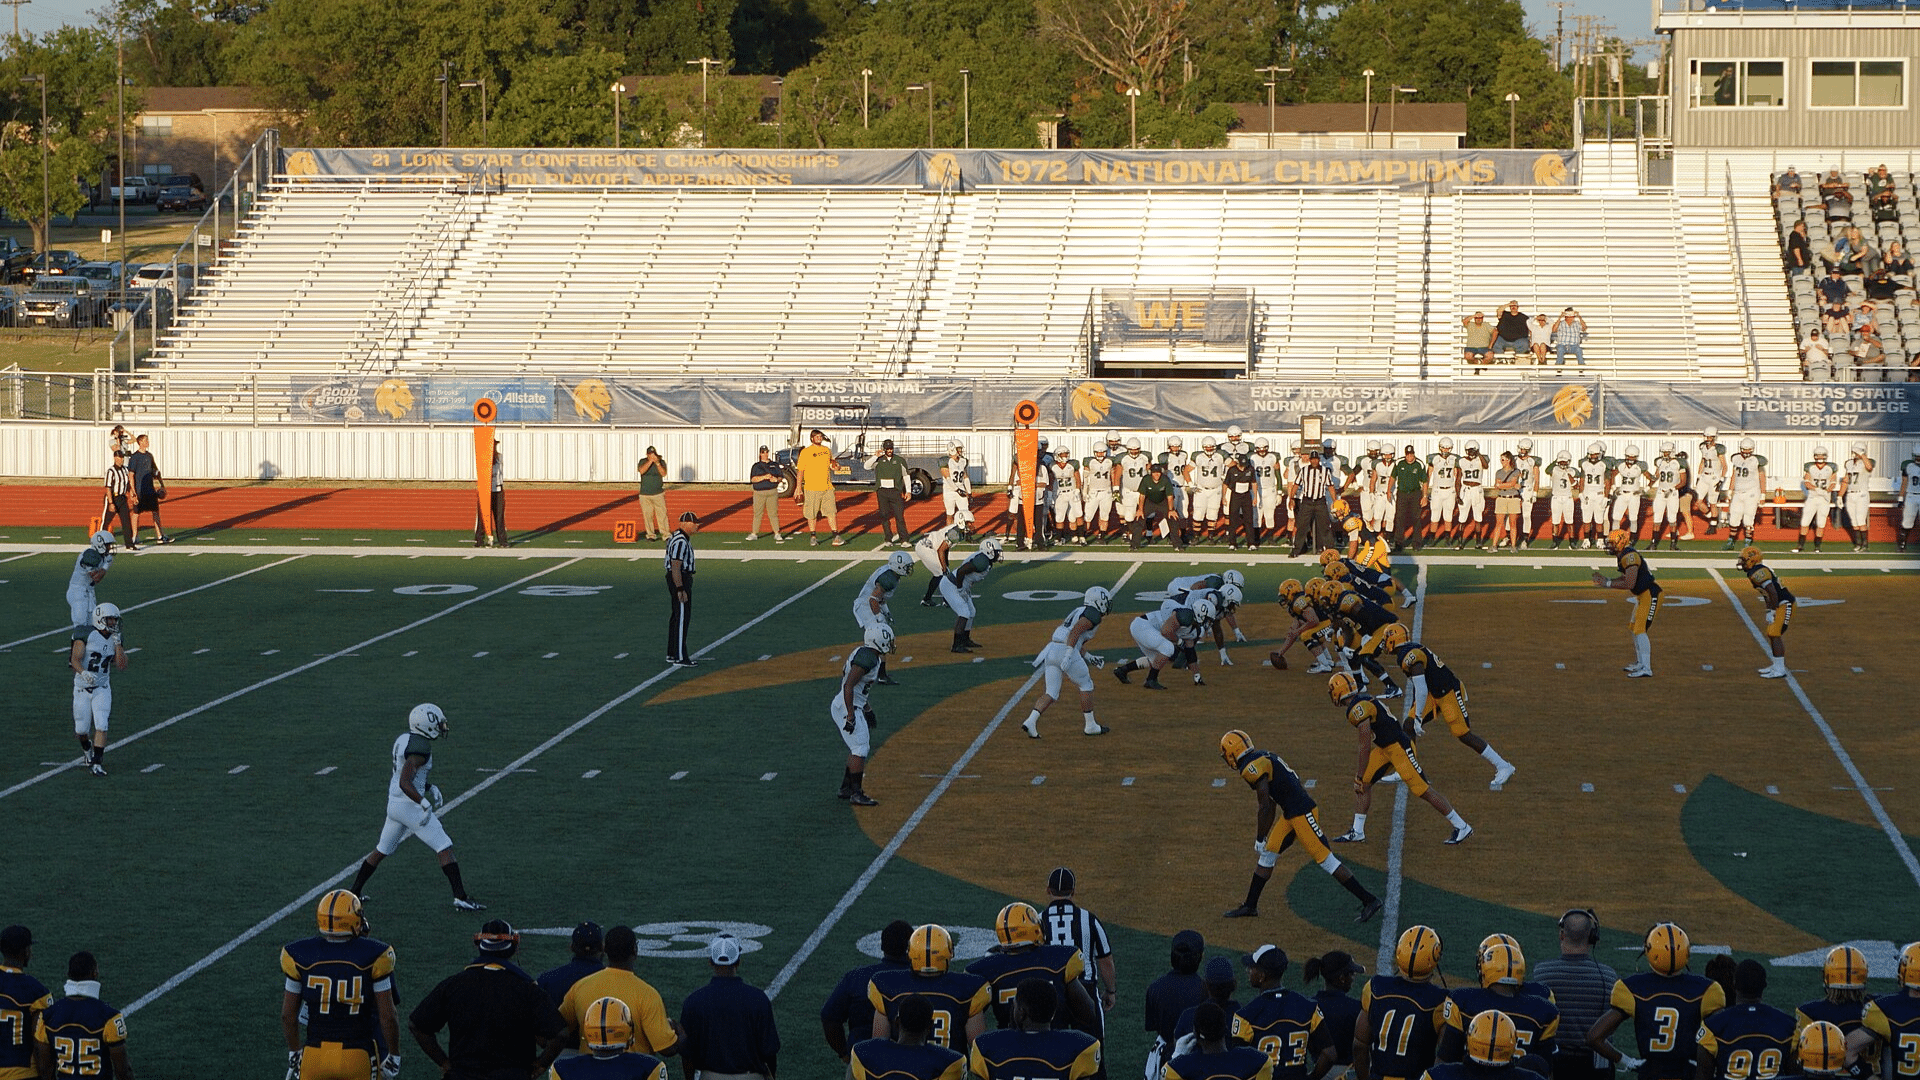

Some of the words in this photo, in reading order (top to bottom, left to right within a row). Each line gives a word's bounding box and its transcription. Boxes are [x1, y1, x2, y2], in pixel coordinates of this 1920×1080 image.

[371, 153, 390, 167] 21
[401, 153, 454, 167] LONE
[461, 153, 513, 167] STAR
[520, 153, 657, 168] CONFERENCE
[664, 153, 840, 168] CHAMPIONSHIPS
[1000, 159, 1068, 184] 1972
[1082, 159, 1260, 184] NATIONAL
[1273, 159, 1496, 184] CHAMPIONS
[544, 173, 634, 185] PLAYOFF
[642, 173, 793, 185] APPEARANCES
[1134, 301, 1207, 329] WE
[321, 387, 359, 397] GOOD
[744, 382, 787, 394] EAST
[794, 382, 847, 394] TEXAS
[853, 382, 926, 394] NORMAL
[1250, 386, 1292, 398] EAST
[1300, 386, 1355, 399] TEXAS
[1360, 386, 1412, 399] STATE
[1740, 386, 1785, 399] EAST
[1790, 387, 1847, 399] TEXAS
[1852, 387, 1905, 399] STATE
[314, 396, 362, 406] SPORT
[503, 392, 547, 404] Allstate
[1253, 400, 1327, 412] NORMAL
[1332, 400, 1408, 413] COLLEGE
[1735, 400, 1827, 413] TEACHERS
[1831, 401, 1910, 414] COLLEGE
[801, 409, 869, 421] 1889-1917
[1785, 413, 1859, 426] 1923-1957
[1202, 466, 1217, 478] 54
[616, 522, 635, 539] 20
[87, 651, 114, 674] 24
[1050, 914, 1075, 947] H
[306, 975, 365, 1016] 74
[1379, 1009, 1416, 1057] 11
[1649, 1006, 1680, 1053] 3
[55, 1036, 103, 1077] 25
